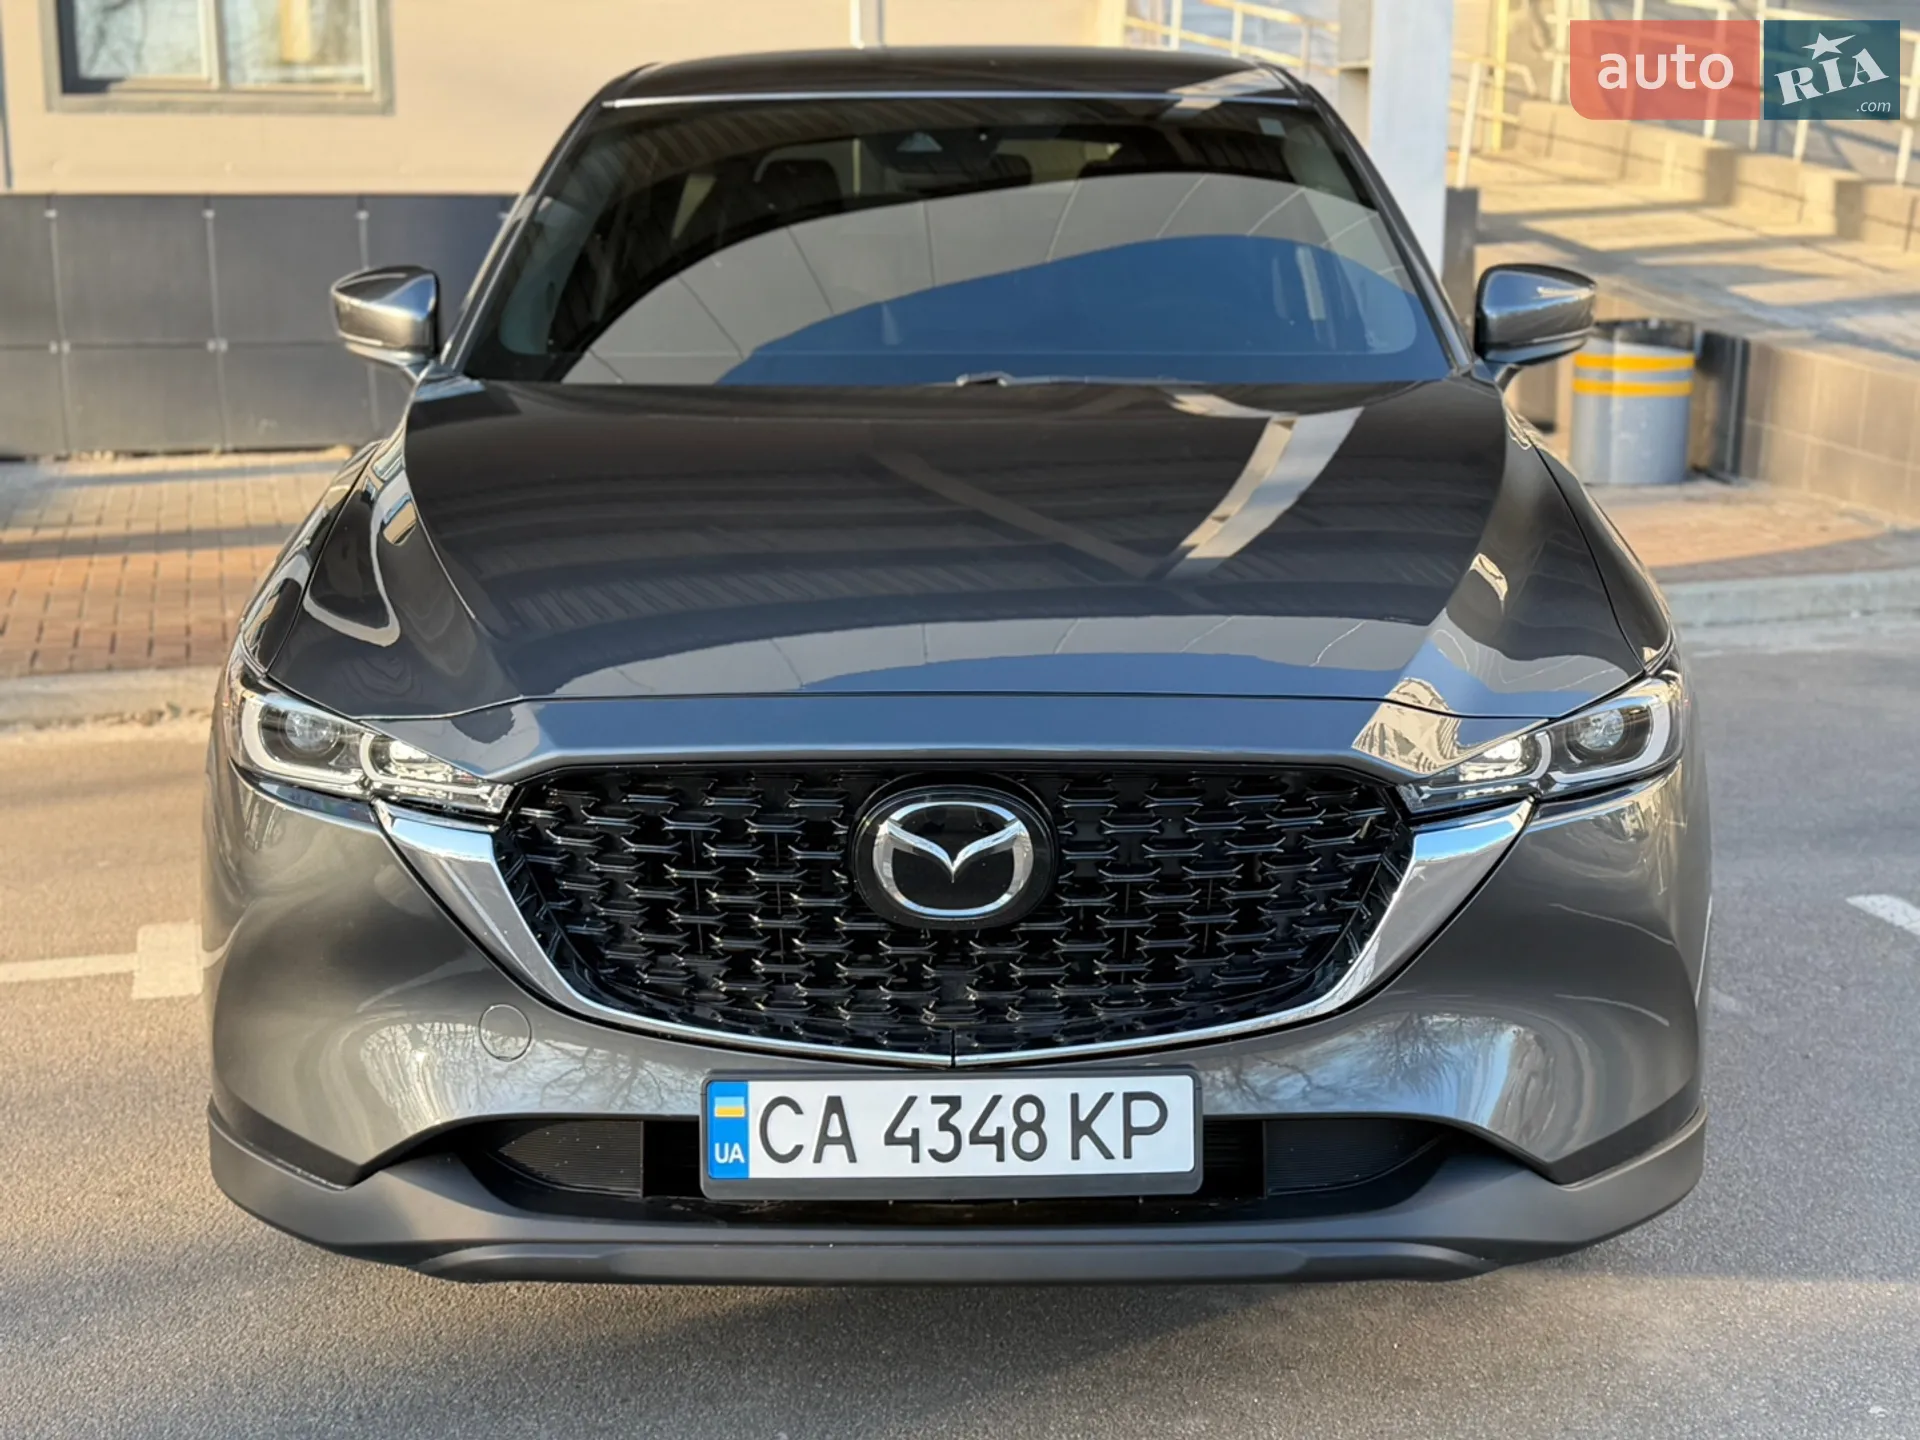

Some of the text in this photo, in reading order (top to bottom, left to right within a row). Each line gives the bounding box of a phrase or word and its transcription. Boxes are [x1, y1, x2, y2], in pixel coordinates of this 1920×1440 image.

[759, 1090, 1169, 1164] CA 4348 KP
[714, 1142, 745, 1164] UA
